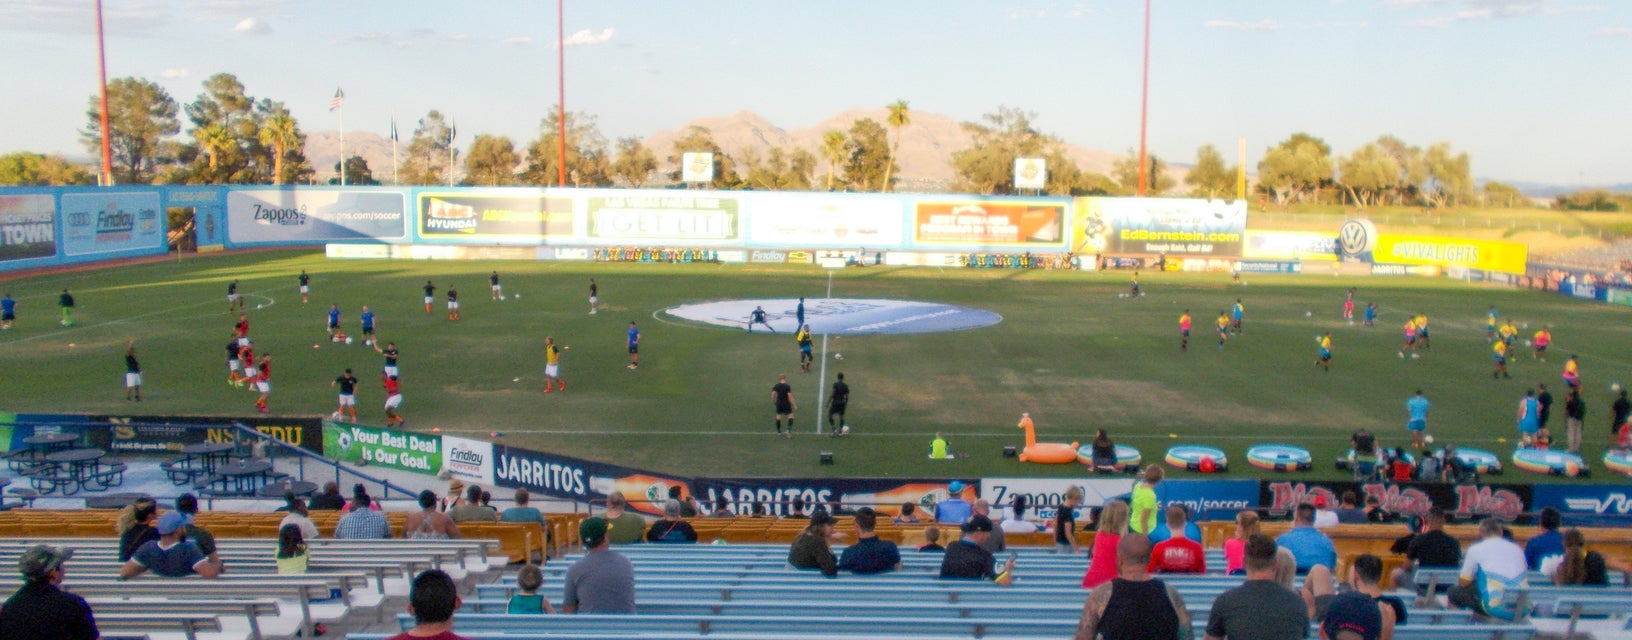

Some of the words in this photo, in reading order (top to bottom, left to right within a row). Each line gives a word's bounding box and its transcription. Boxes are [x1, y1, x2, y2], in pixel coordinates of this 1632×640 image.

[97, 209, 134, 232] Findlay
[253, 204, 300, 223] Zappos
[427, 218, 477, 229] HYUNDAI
[3, 223, 53, 245] TOWN
[612, 215, 664, 233] GET
[678, 215, 713, 233] LIT
[1120, 229, 1240, 243] EdBernstein.com
[752, 250, 786, 262] Findlay
[351, 427, 378, 443] Your
[381, 432, 407, 450] Best
[409, 436, 436, 453] Deal
[362, 446, 372, 461] Is
[375, 448, 397, 464] Our
[400, 452, 430, 470] Goal.
[450, 447, 483, 465] Findlay
[497, 454, 585, 495] JARRITOS
[700, 488, 832, 515] JARRITOS
